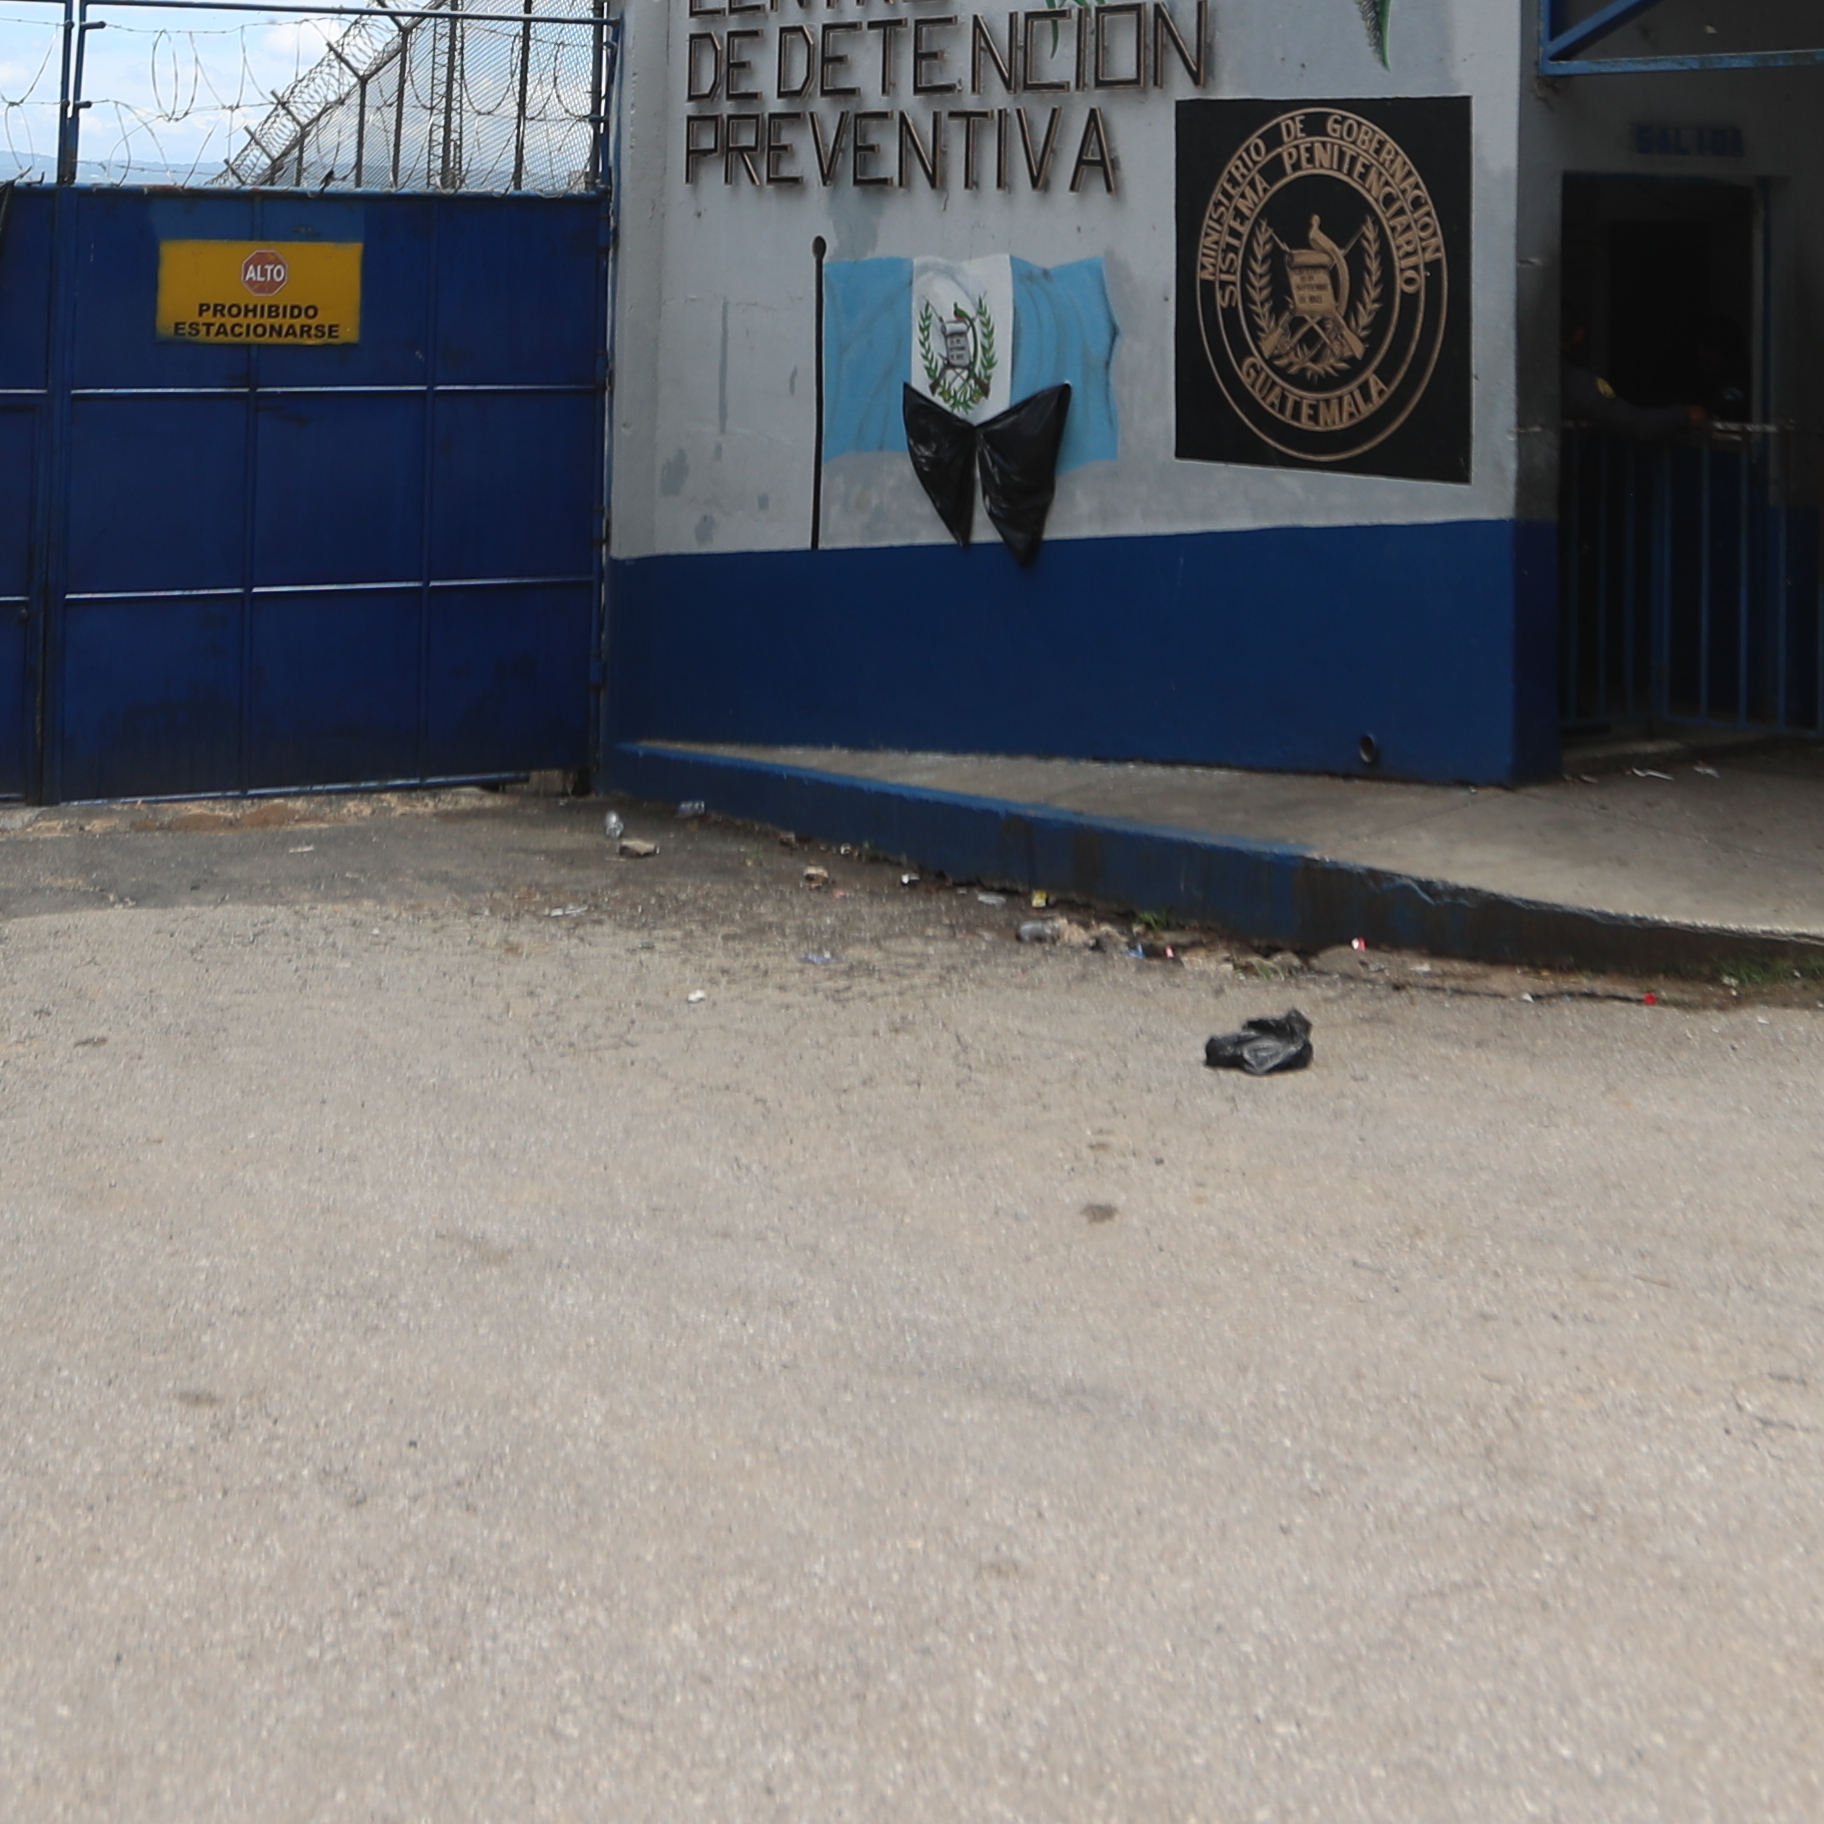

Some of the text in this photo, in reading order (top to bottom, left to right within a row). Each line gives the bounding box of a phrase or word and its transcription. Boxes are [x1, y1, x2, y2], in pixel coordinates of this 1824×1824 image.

[685, 103, 1117, 193] PREVENTIVA
[1637, 125, 1744, 157] SALIDA
[1200, 114, 1443, 281] MINISTERIO DE GOBERNACION
[1220, 142, 1420, 308] SISTEMA PENITENCIARIO
[245, 264, 284, 282] ALTO
[174, 322, 340, 339] ESTACIONARSE
[198, 304, 318, 320] PROHIBIDO
[1240, 355, 1390, 428] GUATEMALA
